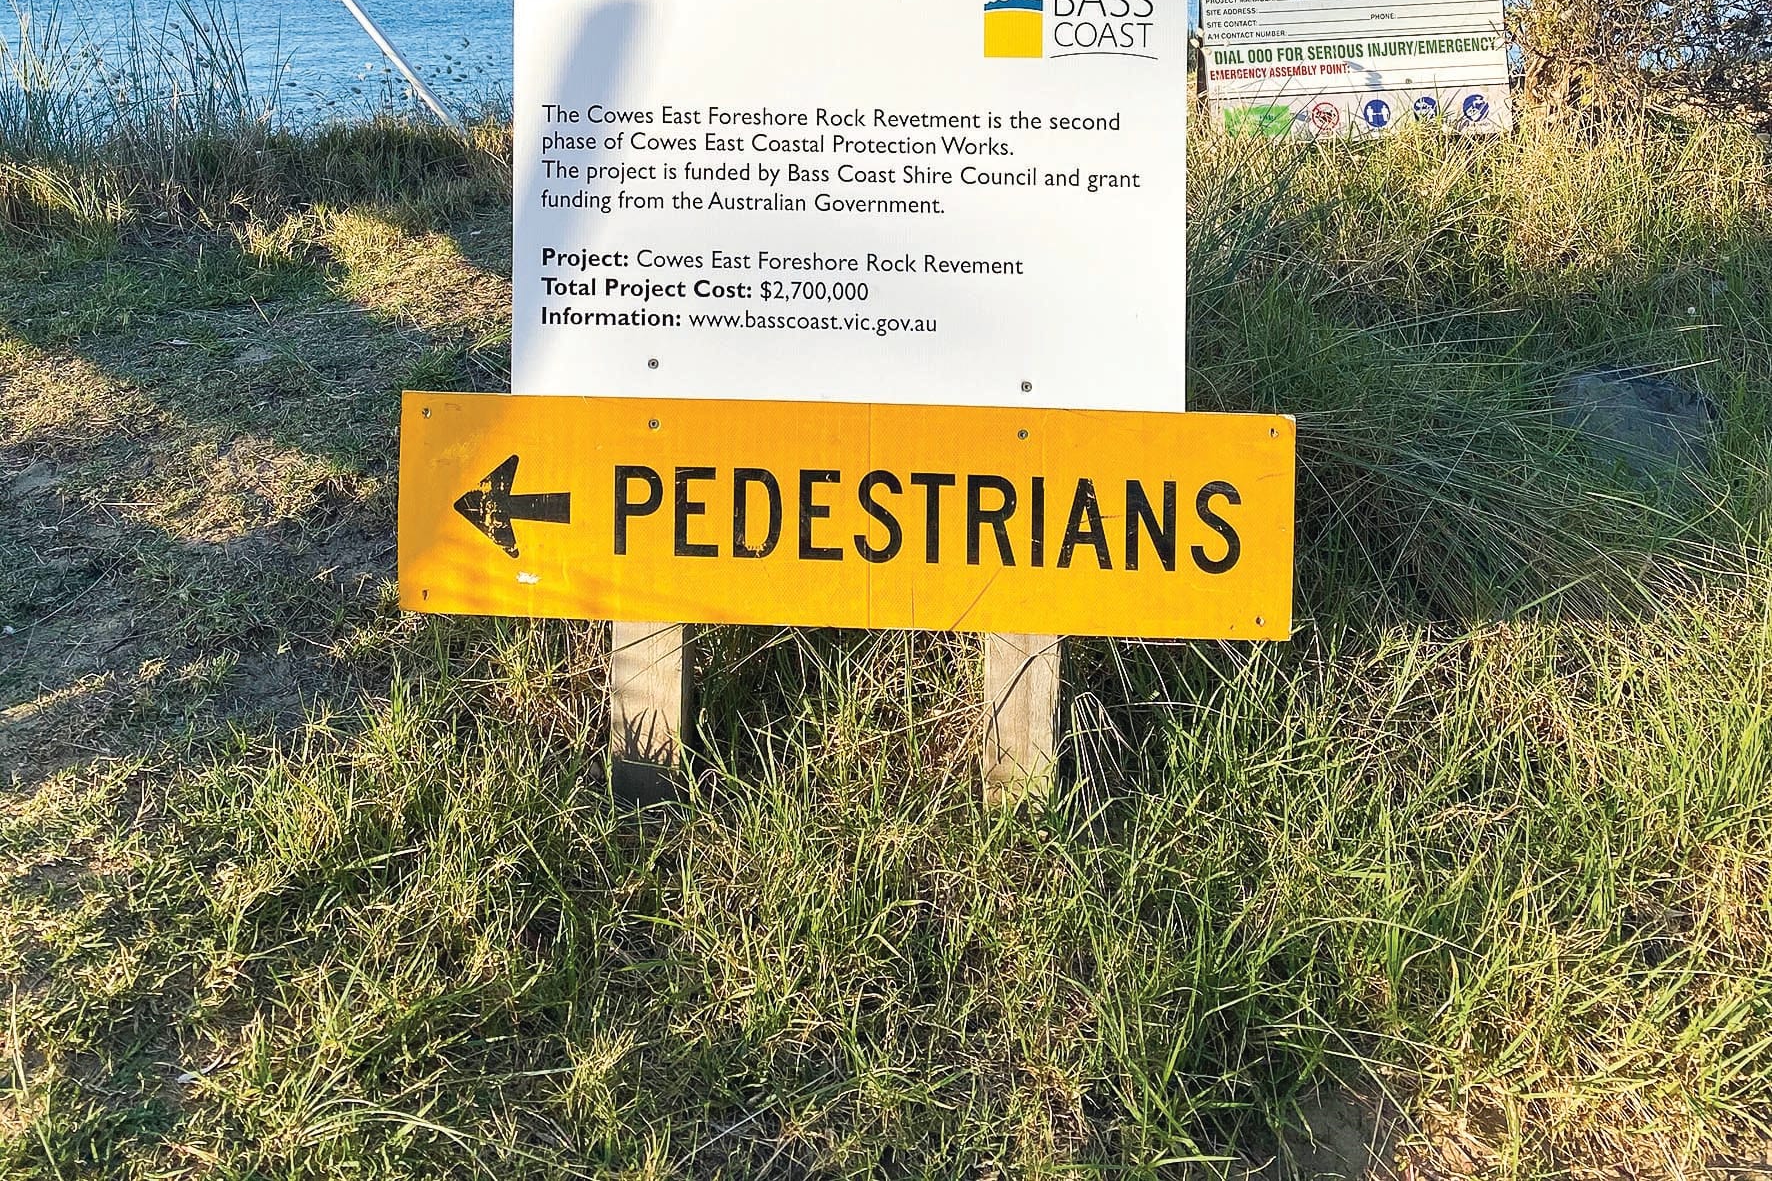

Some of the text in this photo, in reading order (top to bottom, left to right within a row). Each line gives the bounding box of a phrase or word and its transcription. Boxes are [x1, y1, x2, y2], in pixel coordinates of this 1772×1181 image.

[1054, 21, 1153, 48] COAST
[1214, 49, 1244, 65] DIAL
[1247, 48, 1272, 63] 000
[1276, 46, 1304, 62] FOR
[1307, 43, 1363, 60] SERIOUS
[1209, 60, 1351, 81] EMERGENCY ASSEMBLY POINT:
[541, 104, 1119, 130] The Cowes East Foreshore Rock Revetment is the second
[542, 247, 1023, 274] Project: Cowes East Foreshore Rock Revement
[540, 276, 868, 302] Total Project Cost: $2,700,000
[541, 306, 936, 336] Information: www.basscoast.vic.gov.au
[614, 465, 1241, 574] PEDESTRIANS
